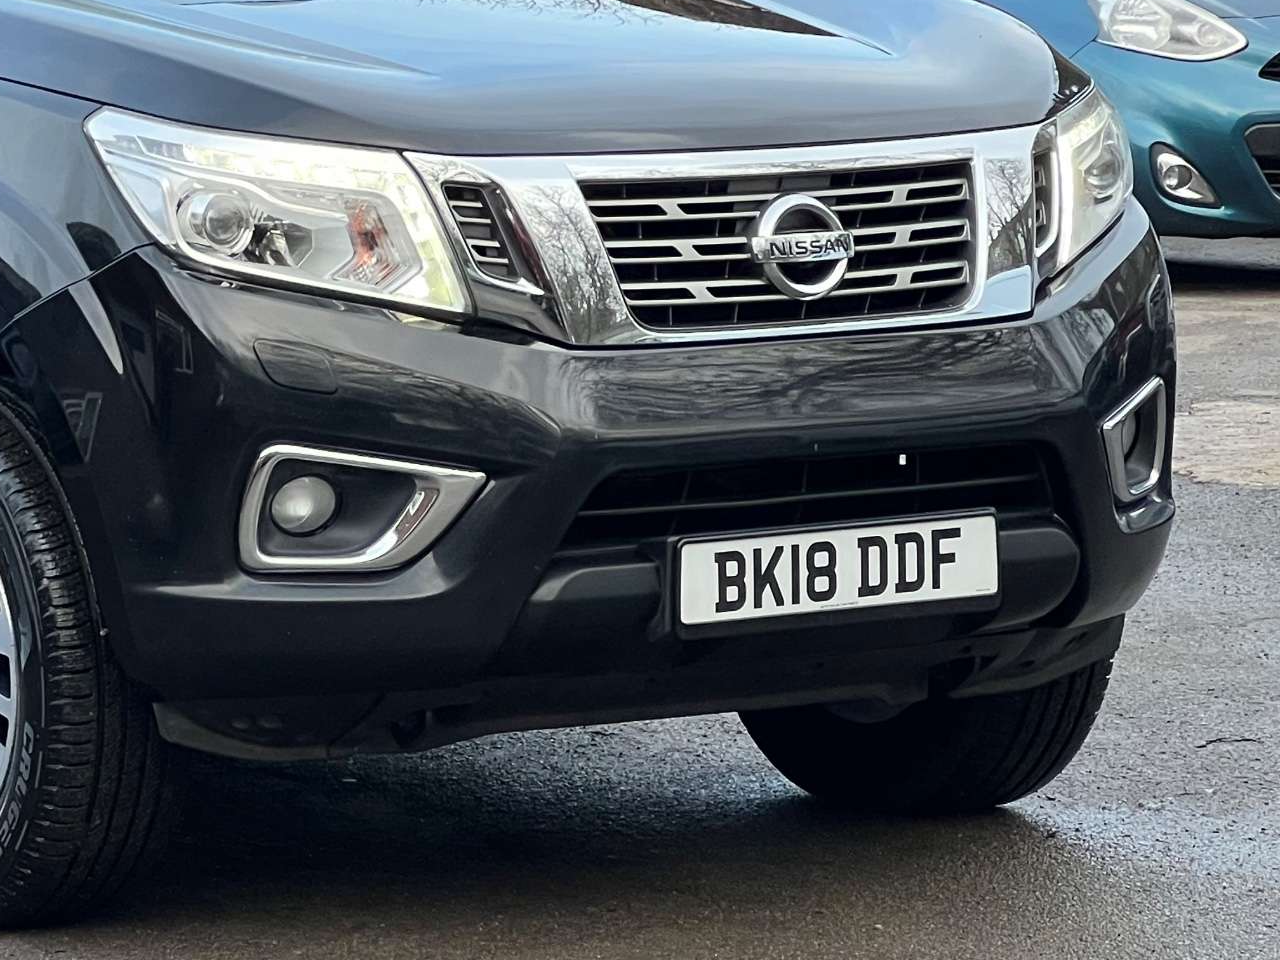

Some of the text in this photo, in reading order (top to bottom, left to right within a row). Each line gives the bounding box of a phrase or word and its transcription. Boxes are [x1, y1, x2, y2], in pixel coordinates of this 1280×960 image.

[769, 235, 849, 256] NISSAN
[714, 527, 961, 613] BK18 DDF
